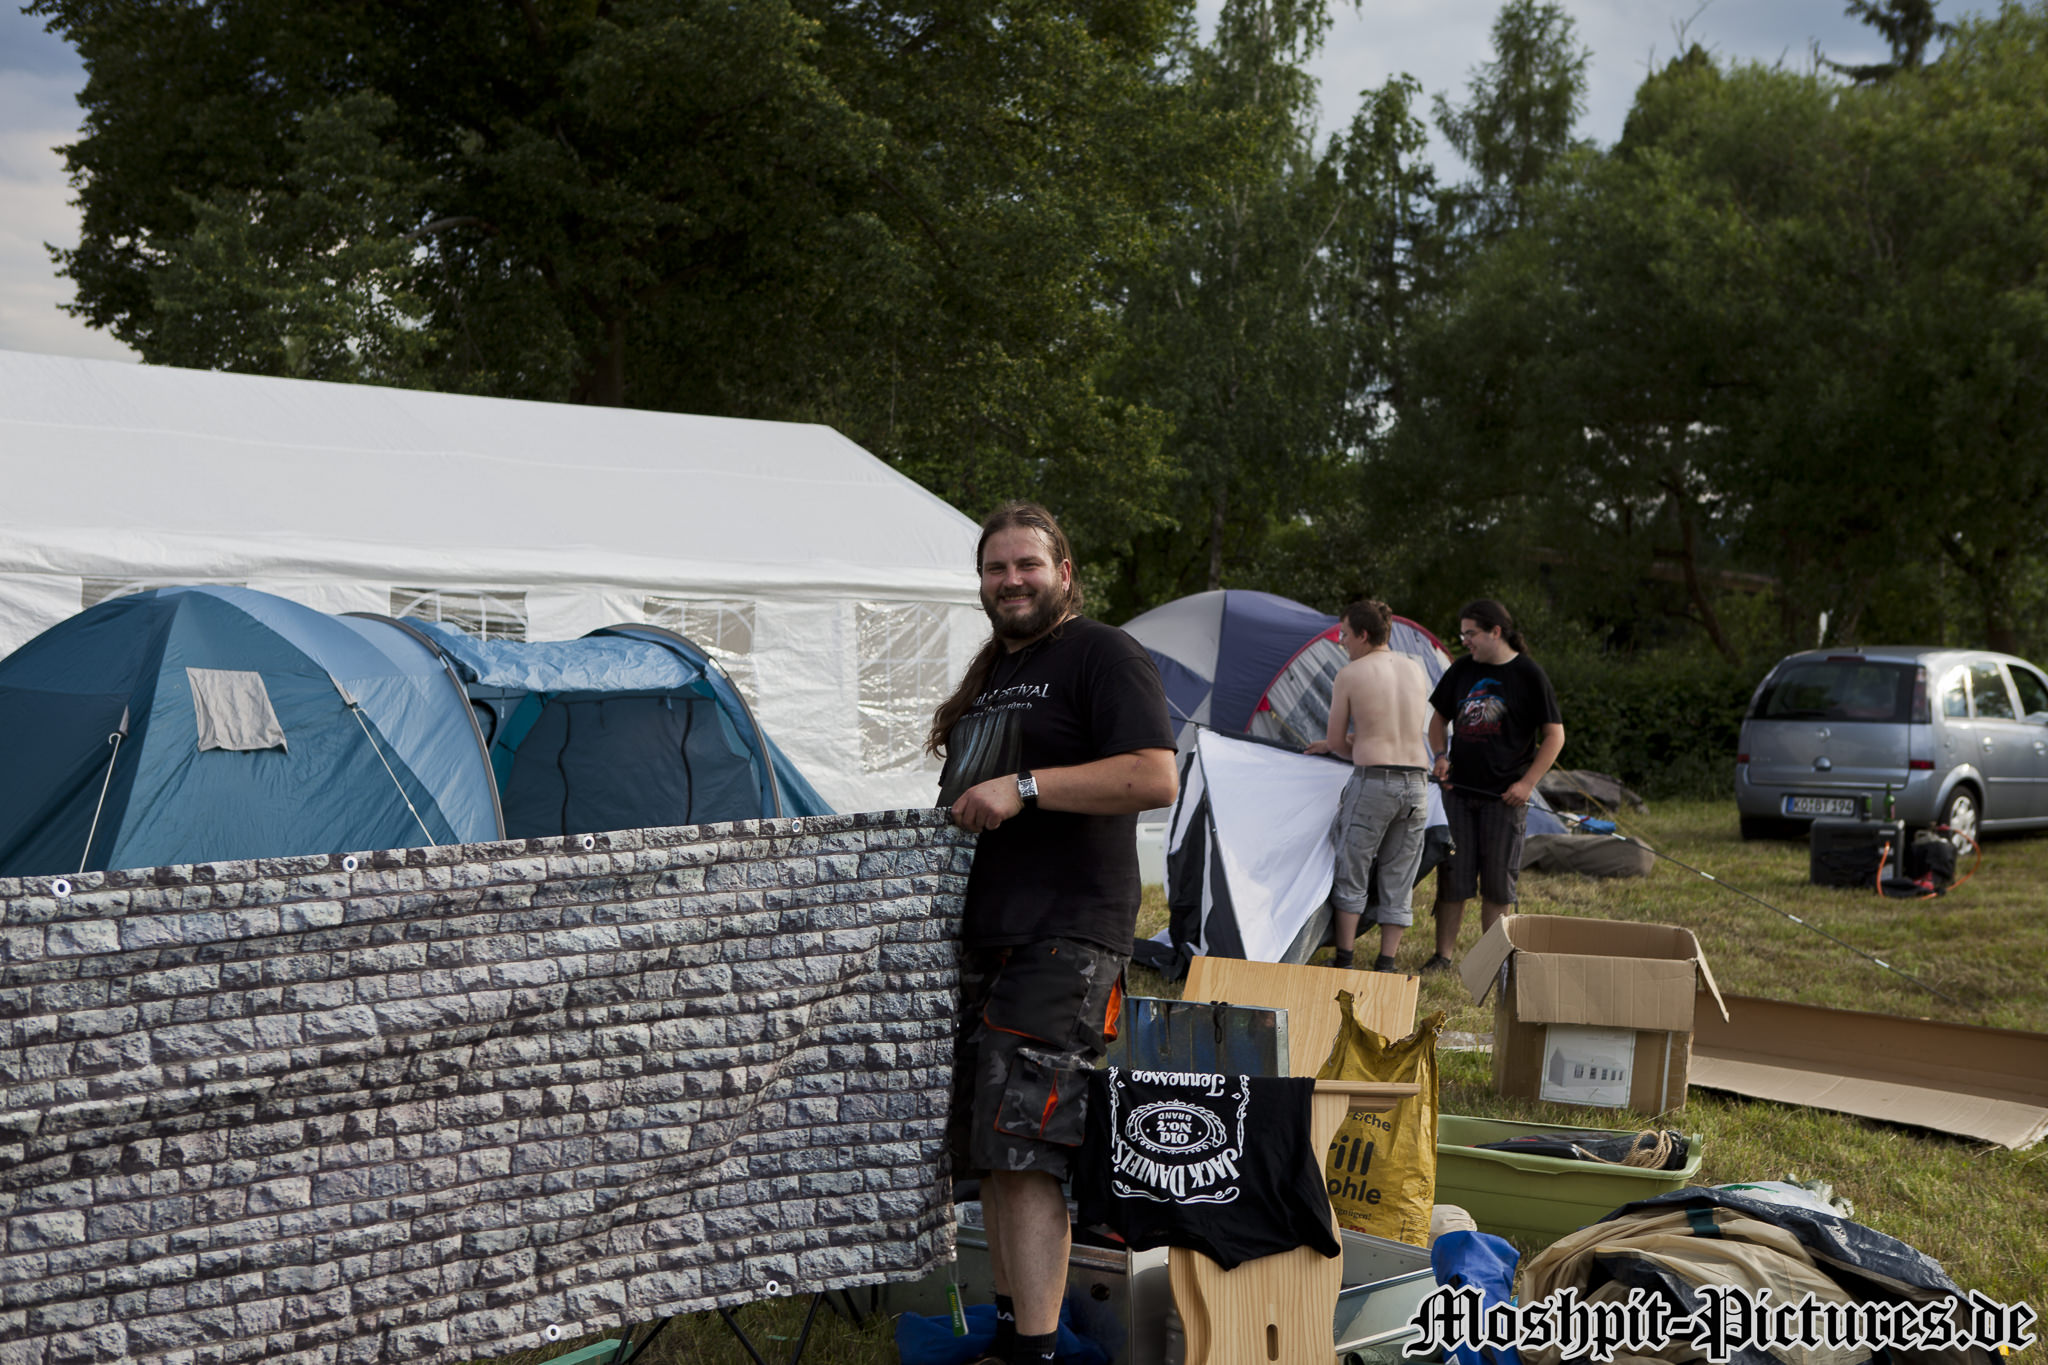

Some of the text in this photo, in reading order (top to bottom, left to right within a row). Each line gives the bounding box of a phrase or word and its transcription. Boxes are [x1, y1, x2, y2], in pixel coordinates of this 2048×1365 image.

[1131, 1069, 1226, 1097] Tennessee
[1156, 1120, 1192, 1133] No.7
[1158, 1112, 1192, 1121] BRAND
[1160, 1132, 1189, 1144] Old
[1111, 1140, 1240, 1197] JACK DANIEL'S
[1327, 1176, 1382, 1205] ohle
